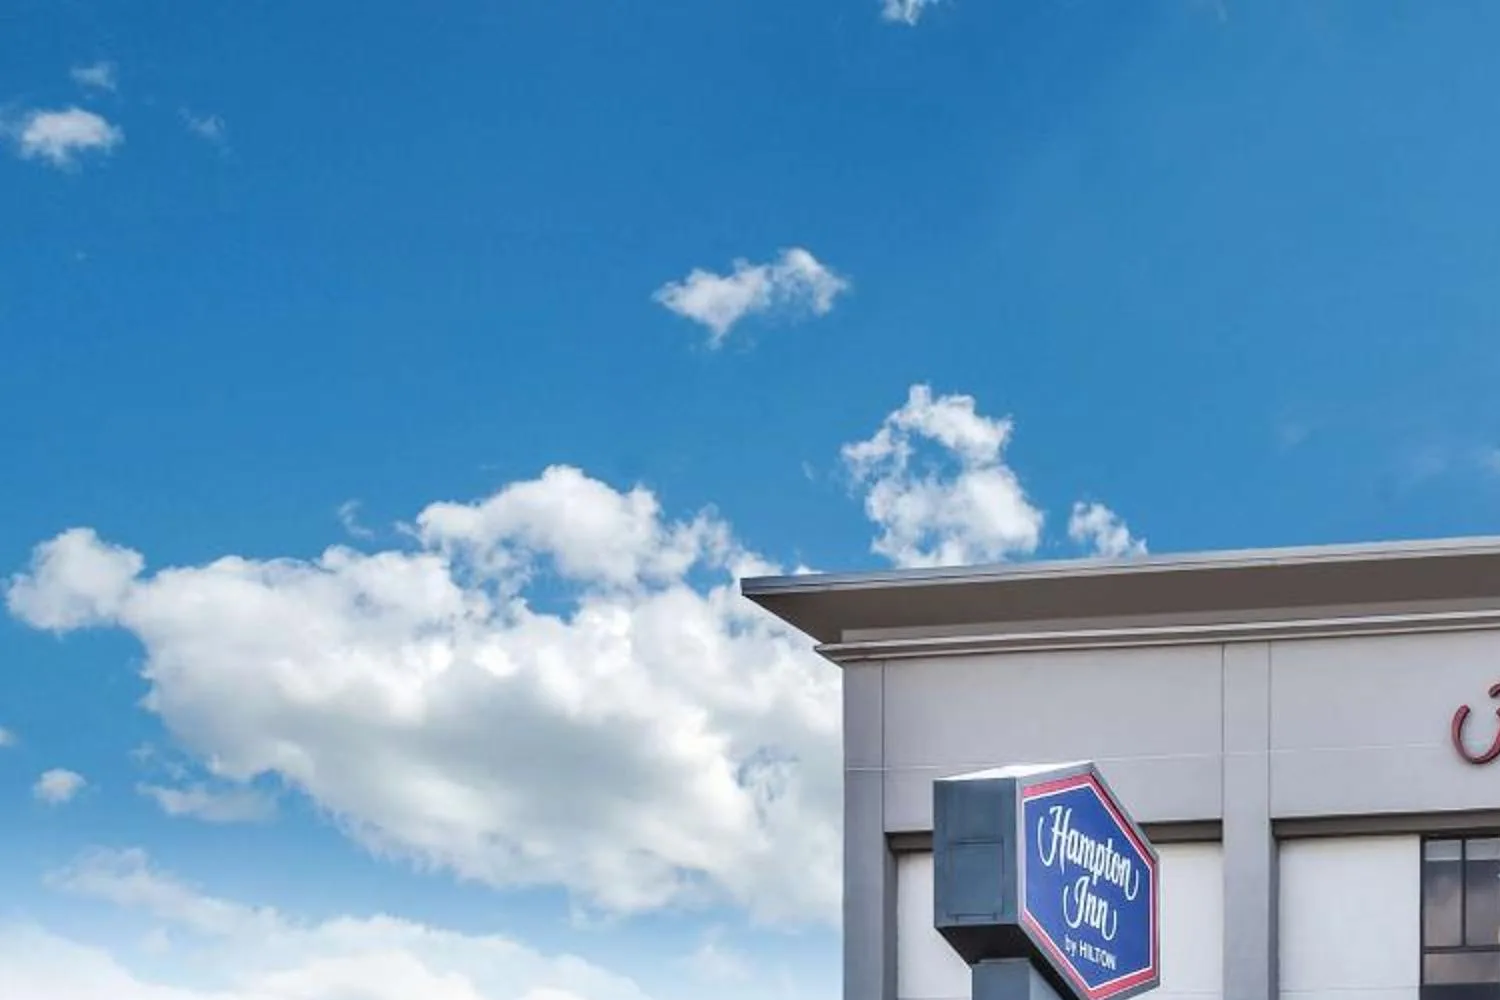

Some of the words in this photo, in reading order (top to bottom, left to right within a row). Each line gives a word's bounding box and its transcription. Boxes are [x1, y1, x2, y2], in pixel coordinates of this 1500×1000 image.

[1038, 806, 1139, 900] Hampton
[1063, 876, 1117, 941] Inn
[1064, 934, 1077, 957] by
[1080, 940, 1116, 970] HILTON
